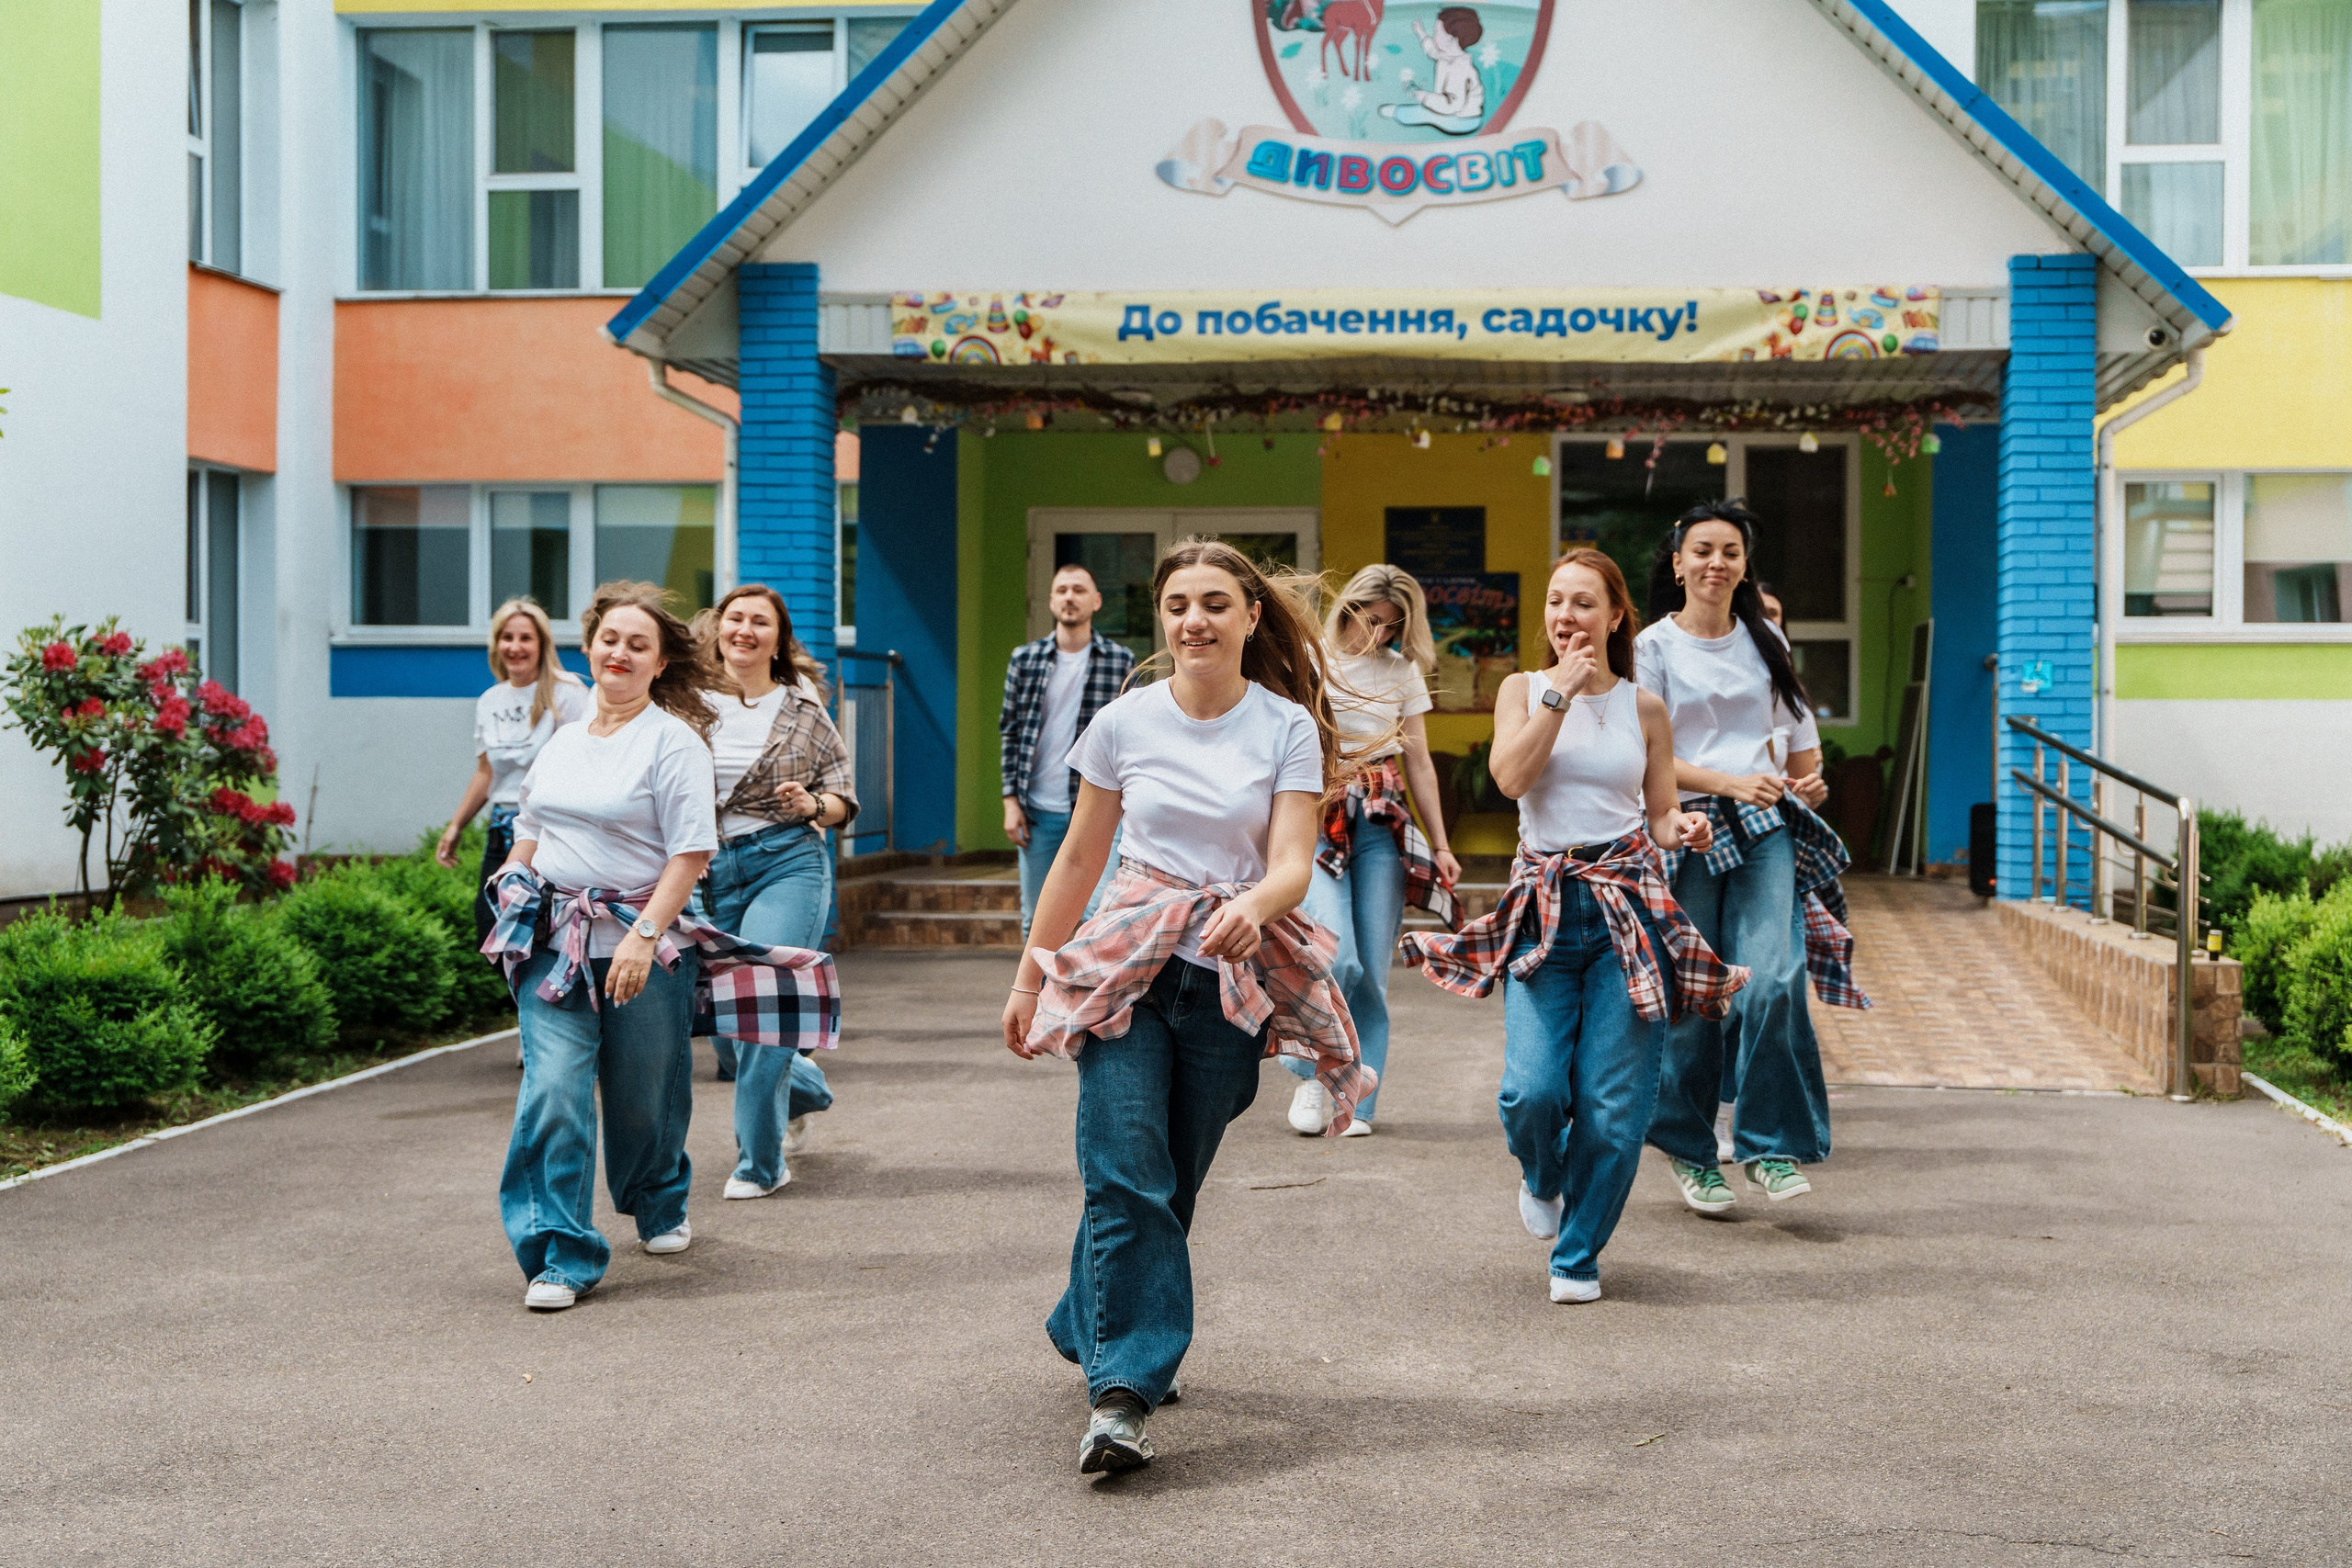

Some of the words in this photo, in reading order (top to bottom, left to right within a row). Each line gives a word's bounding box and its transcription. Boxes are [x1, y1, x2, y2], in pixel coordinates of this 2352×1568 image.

[1247, 140, 1546, 195] ДИВОСВІТ
[1118, 304, 1182, 342] До
[1197, 301, 1467, 340] побачення,
[1482, 300, 1699, 342] садочку!
